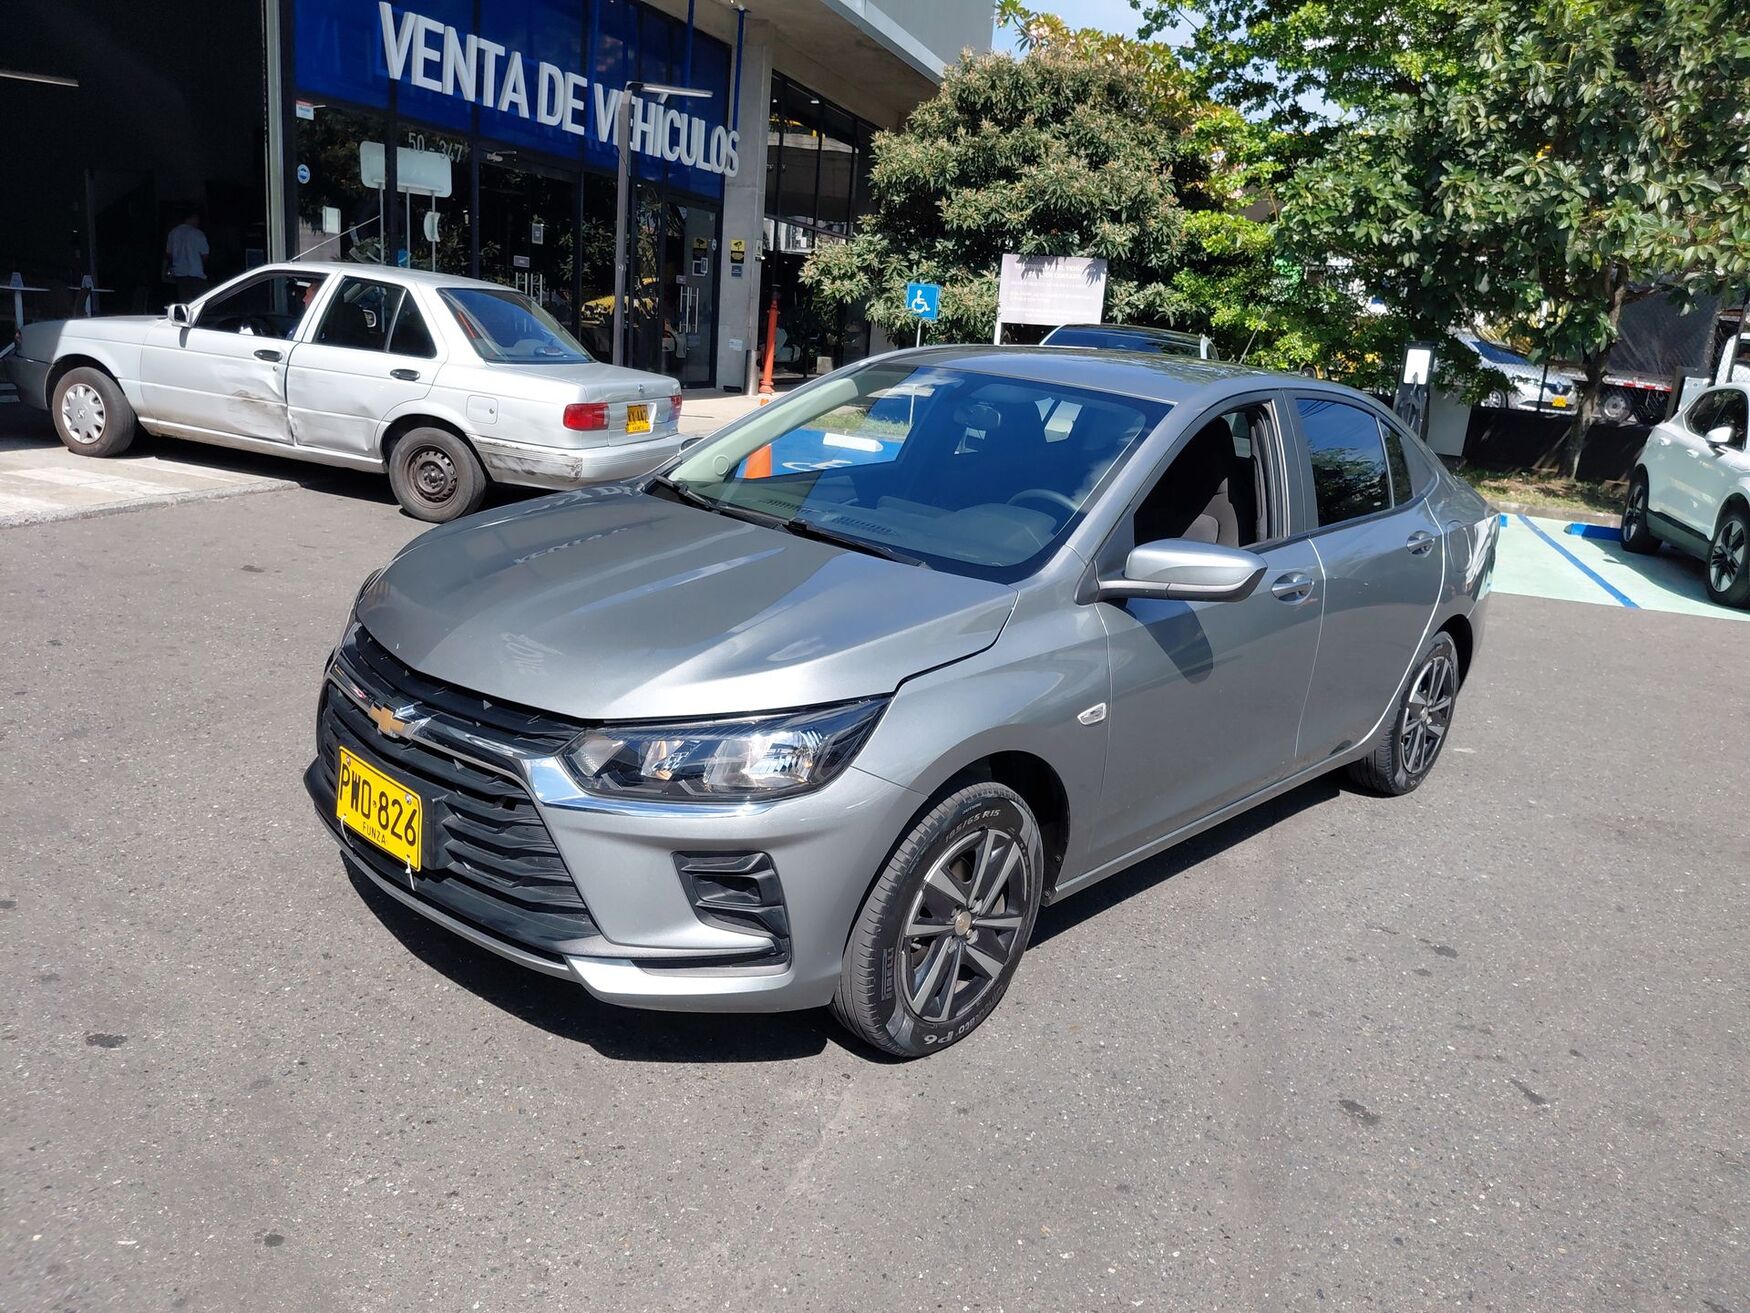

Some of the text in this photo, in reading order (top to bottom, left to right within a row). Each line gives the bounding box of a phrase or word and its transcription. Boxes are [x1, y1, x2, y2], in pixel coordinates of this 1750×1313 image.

[379, 2, 530, 119] VENTA
[537, 61, 588, 136] DE
[408, 132, 425, 153] 50
[982, 809, 1001, 819] R15
[362, 821, 387, 846] FUNZA
[923, 1030, 954, 1045] P6
